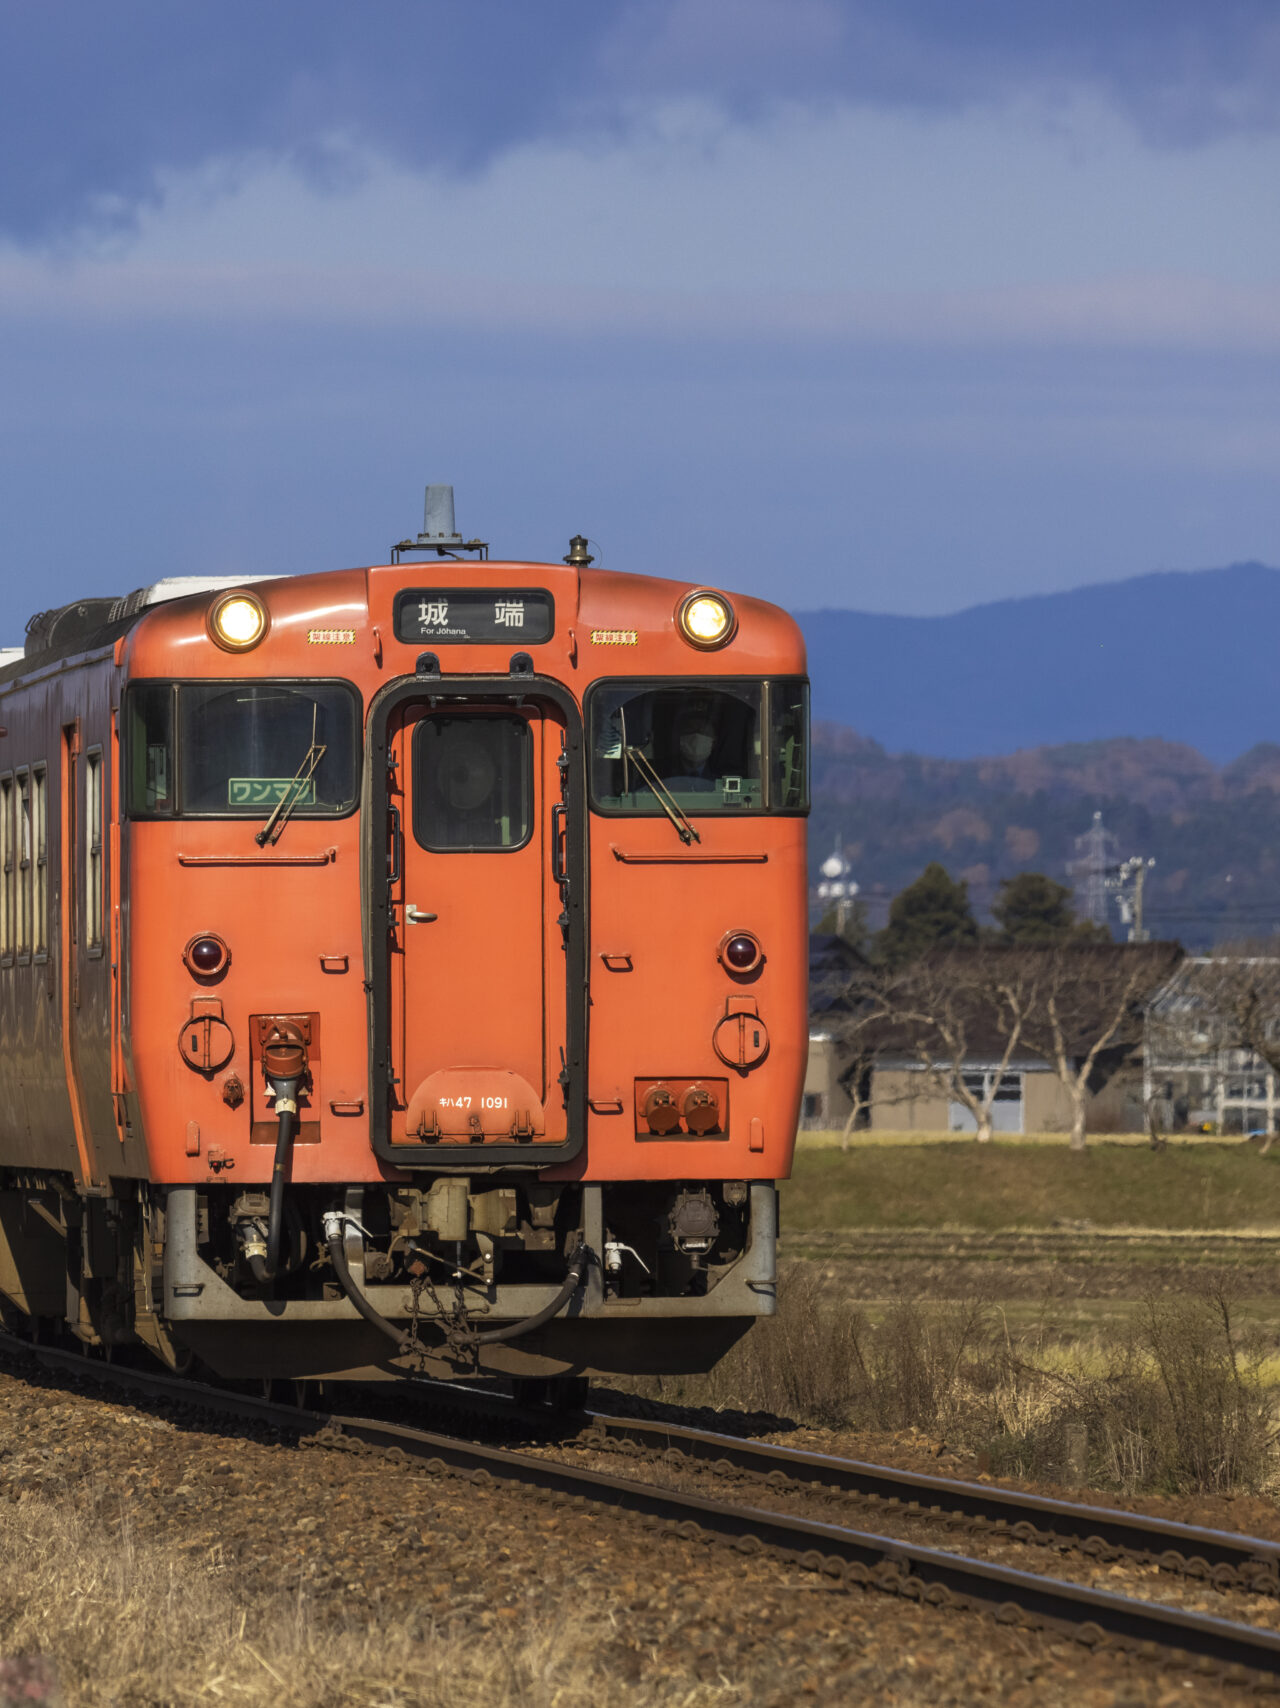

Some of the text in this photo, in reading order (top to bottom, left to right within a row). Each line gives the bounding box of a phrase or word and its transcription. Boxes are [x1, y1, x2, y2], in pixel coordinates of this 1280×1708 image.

[420, 627, 434, 635] For
[233, 783, 310, 801] ワンマン
[439, 1096, 508, 1108] キハ47 1091
